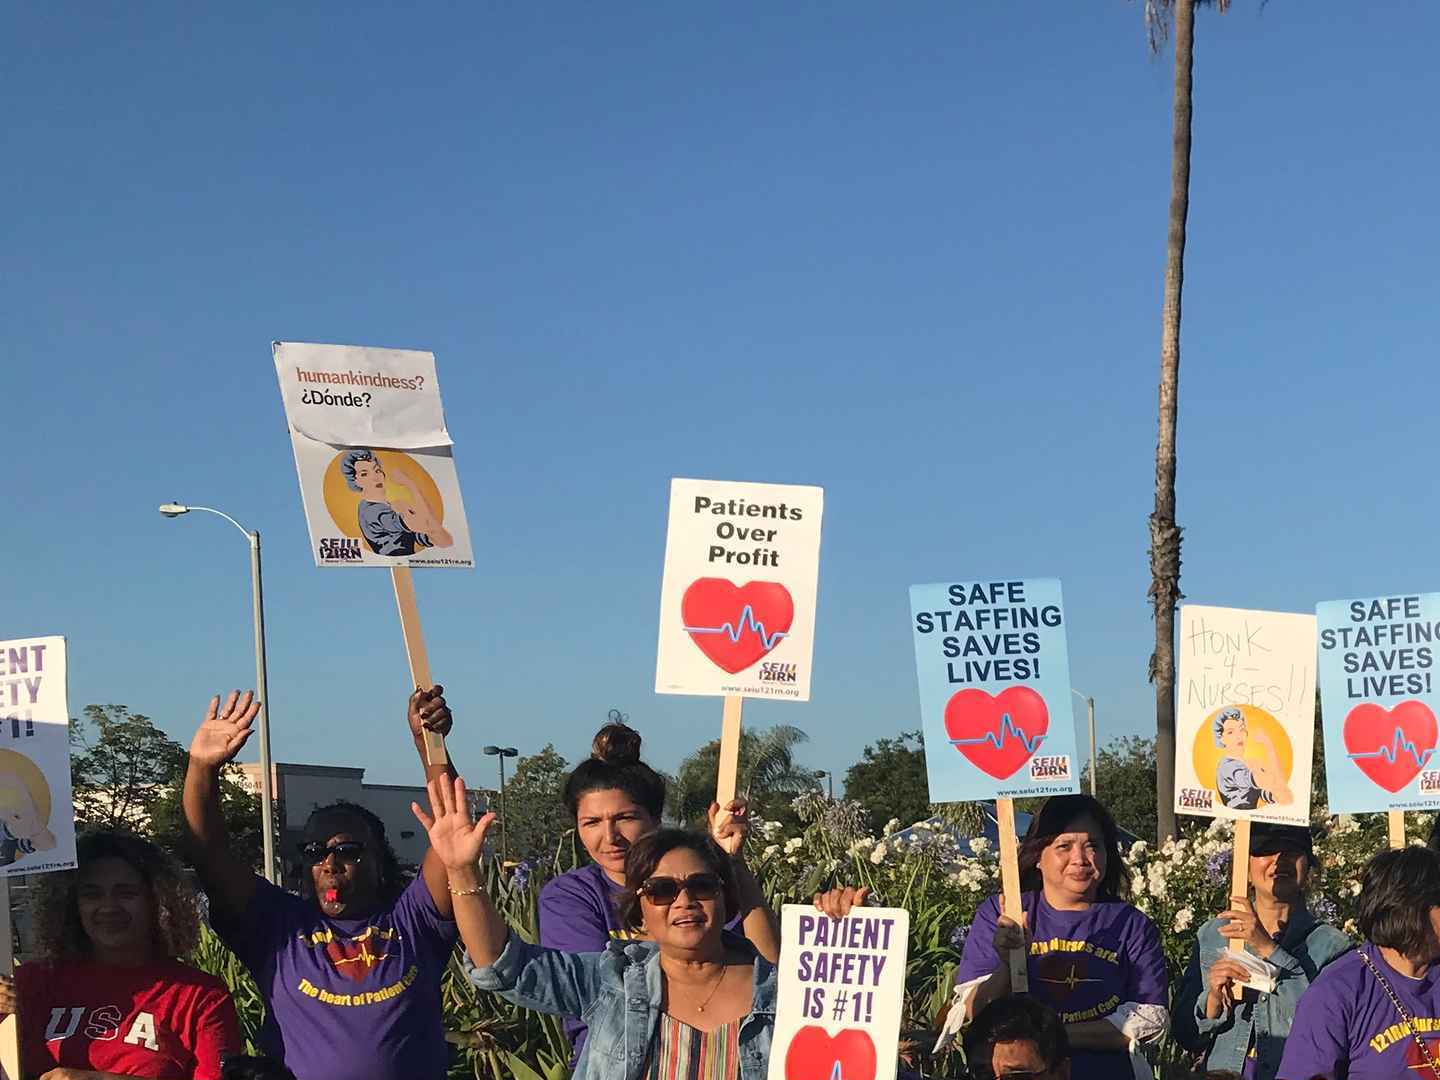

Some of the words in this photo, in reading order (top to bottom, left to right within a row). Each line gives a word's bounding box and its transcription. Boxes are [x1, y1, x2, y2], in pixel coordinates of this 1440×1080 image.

[296, 367, 424, 390] humankindness?
[301, 388, 372, 408] ¿Dónde?
[694, 496, 803, 521] Patients
[716, 522, 777, 542] Over
[708, 545, 779, 567] Profit
[949, 581, 1026, 606] SAFE
[916, 605, 1062, 634] STAFFING
[1350, 597, 1420, 622] SAFE
[942, 632, 1041, 658] SAVES
[1189, 617, 1273, 657] HONK
[947, 658, 1040, 683] LIVES!
[1343, 647, 1433, 673] SAVES
[1347, 673, 1431, 698] LIVES!
[799, 915, 894, 950] PATIENT
[798, 951, 887, 987] SAFETY
[803, 987, 825, 1019] IS
[833, 989, 873, 1023] #1!
[45, 1005, 159, 1052] USA
